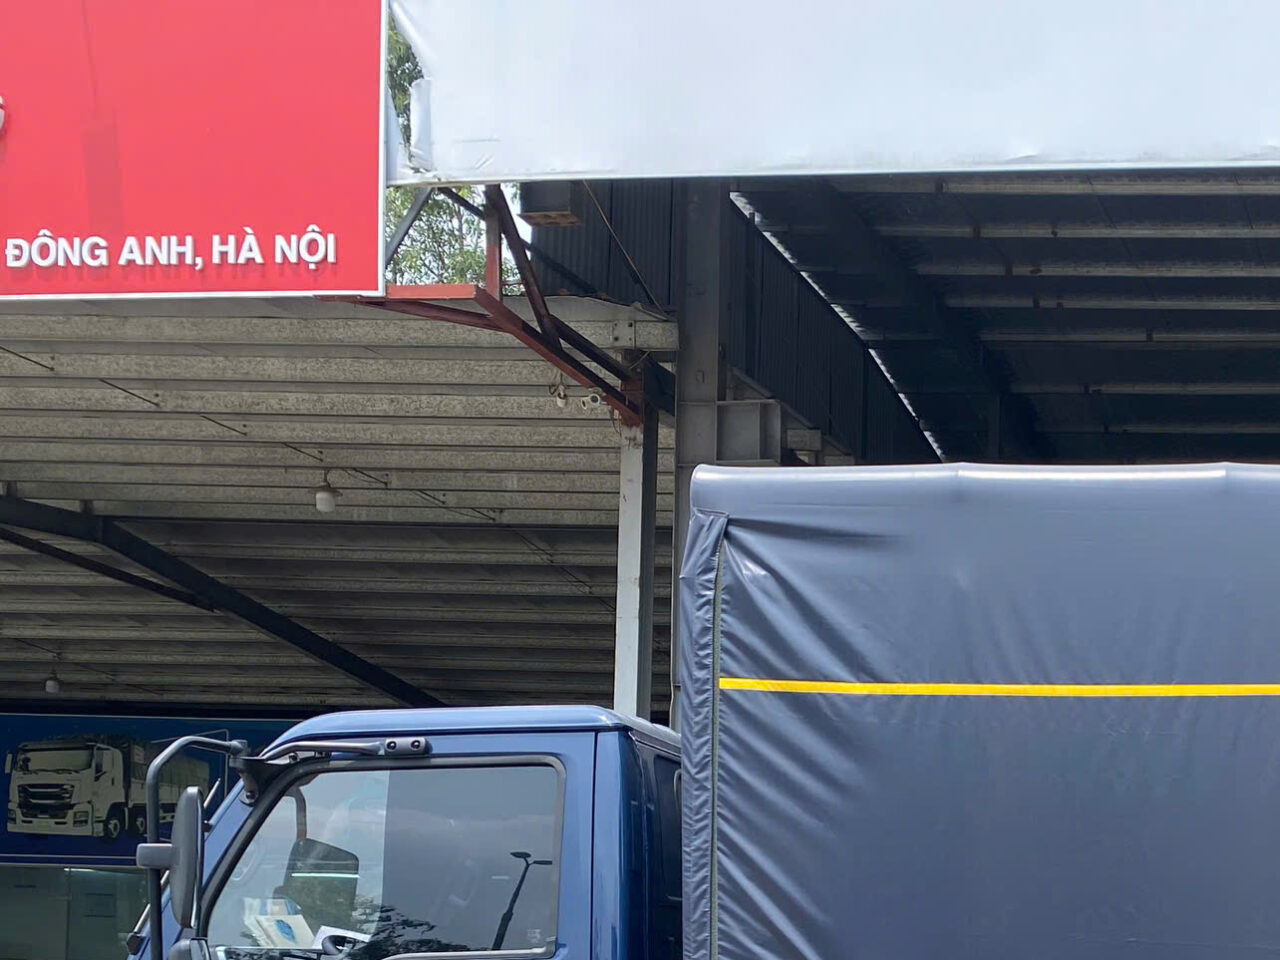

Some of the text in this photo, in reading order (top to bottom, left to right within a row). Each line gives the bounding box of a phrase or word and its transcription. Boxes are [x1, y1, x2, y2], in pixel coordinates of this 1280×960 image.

[6, 224, 336, 269] ĐÔNG ANH, HÀ NỘI
